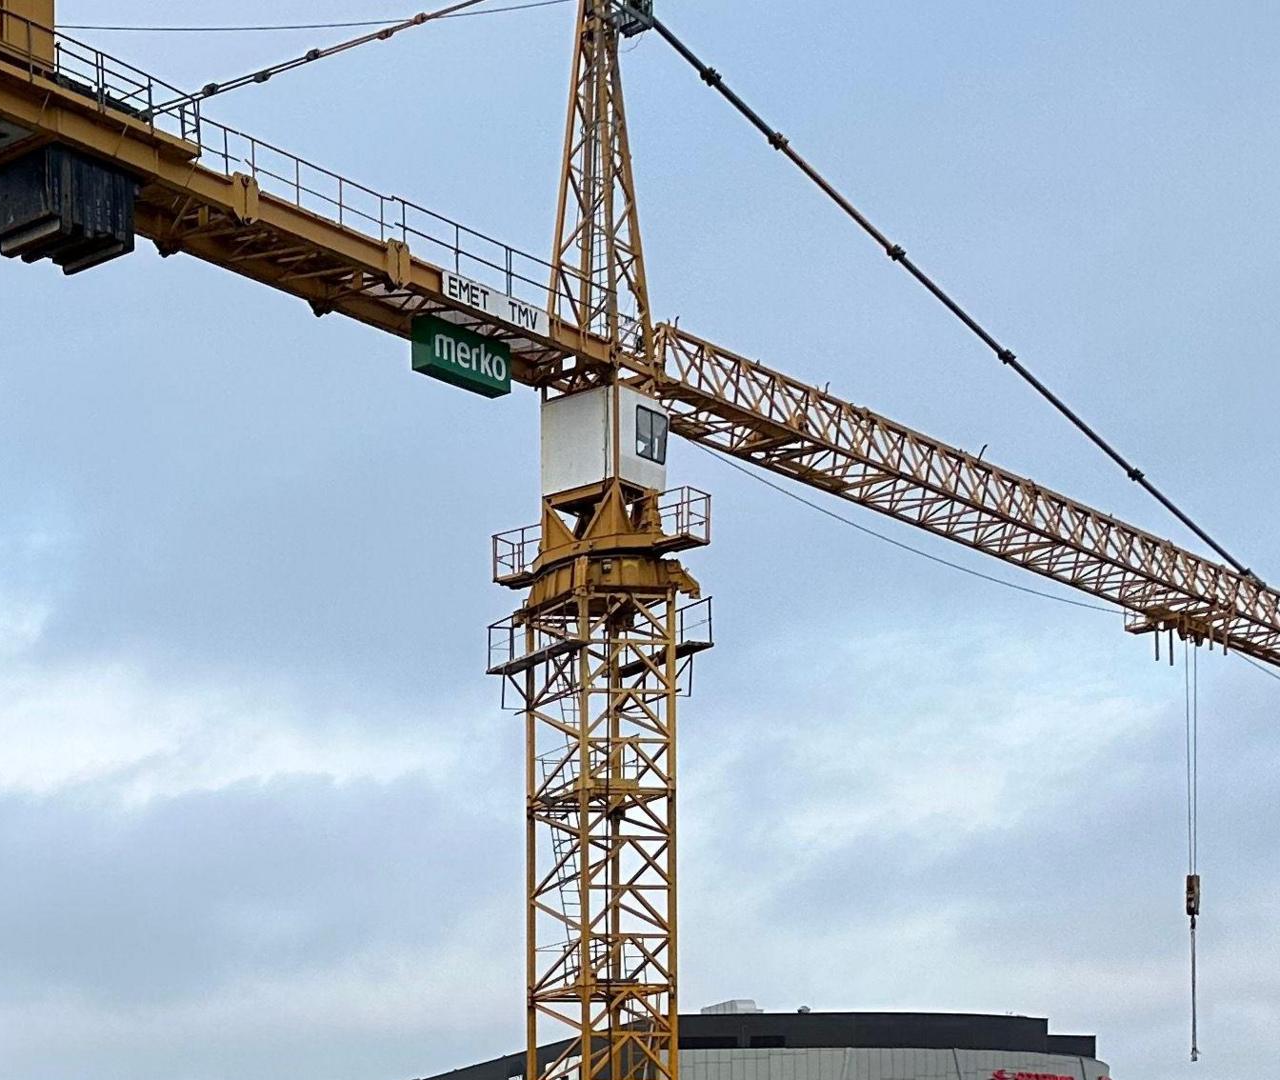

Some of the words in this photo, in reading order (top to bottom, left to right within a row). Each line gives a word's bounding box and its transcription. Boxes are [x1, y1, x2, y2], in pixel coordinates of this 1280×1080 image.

[448, 275, 489, 310] EMET
[508, 300, 538, 330] TMV
[434, 333, 507, 381] merko
